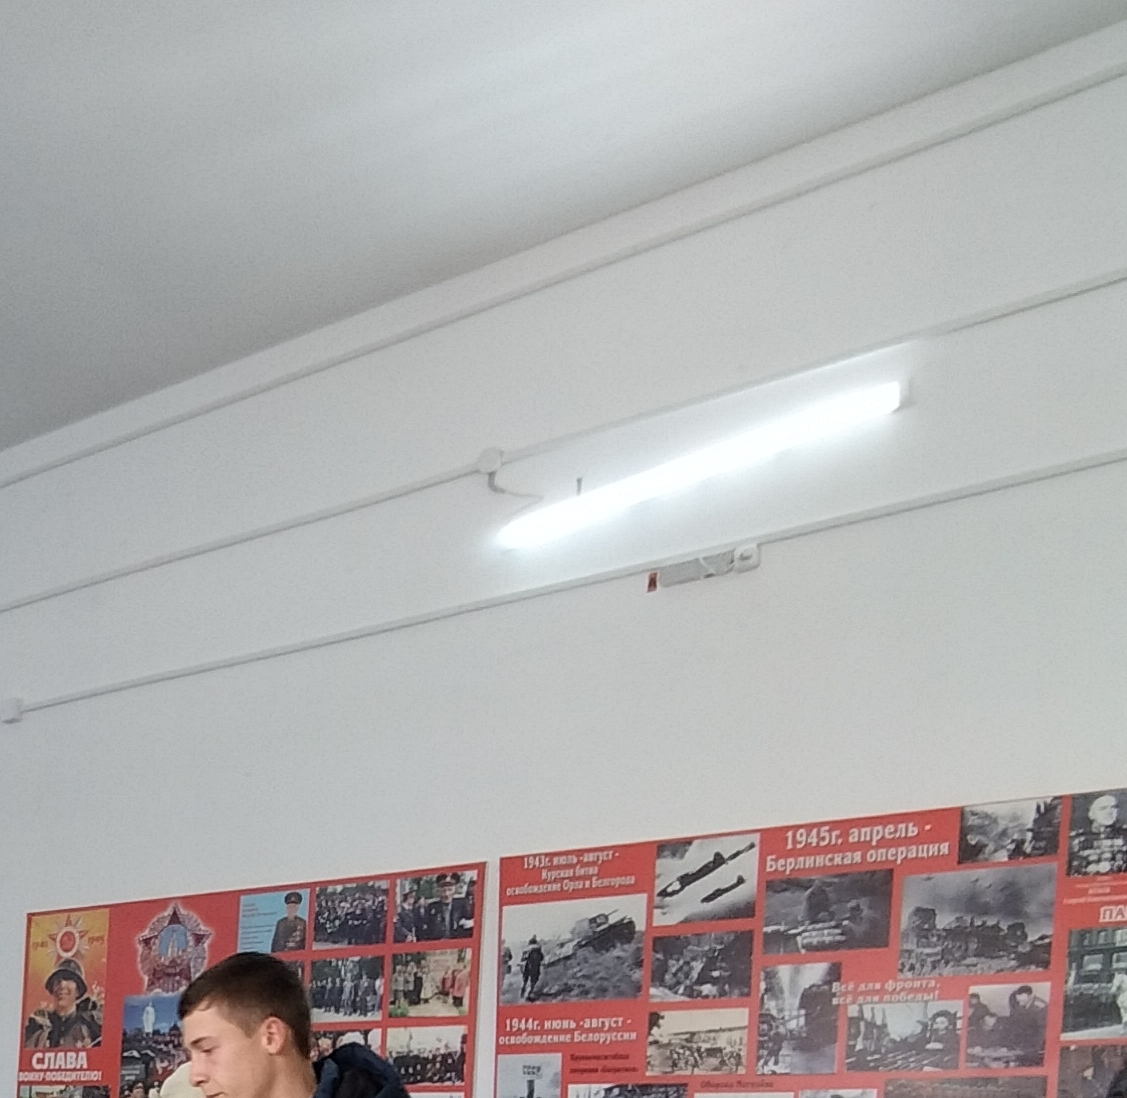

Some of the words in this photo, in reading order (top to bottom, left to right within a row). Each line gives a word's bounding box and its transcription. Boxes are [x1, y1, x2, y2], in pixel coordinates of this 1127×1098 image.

[785, 825, 843, 850] 1945г.
[848, 821, 919, 846] апрель
[765, 850, 862, 875] Берлинская
[866, 841, 950, 865] операция
[831, 981, 855, 993] Всё
[857, 981, 882, 993] для
[856, 994, 881, 1005] для
[882, 989, 940, 1004] победы!
[504, 1017, 542, 1032] 1944г.
[498, 1031, 572, 1045] освобождение
[573, 1030, 638, 1044] Белоруссии
[32, 1051, 88, 1070] СЛАВА
